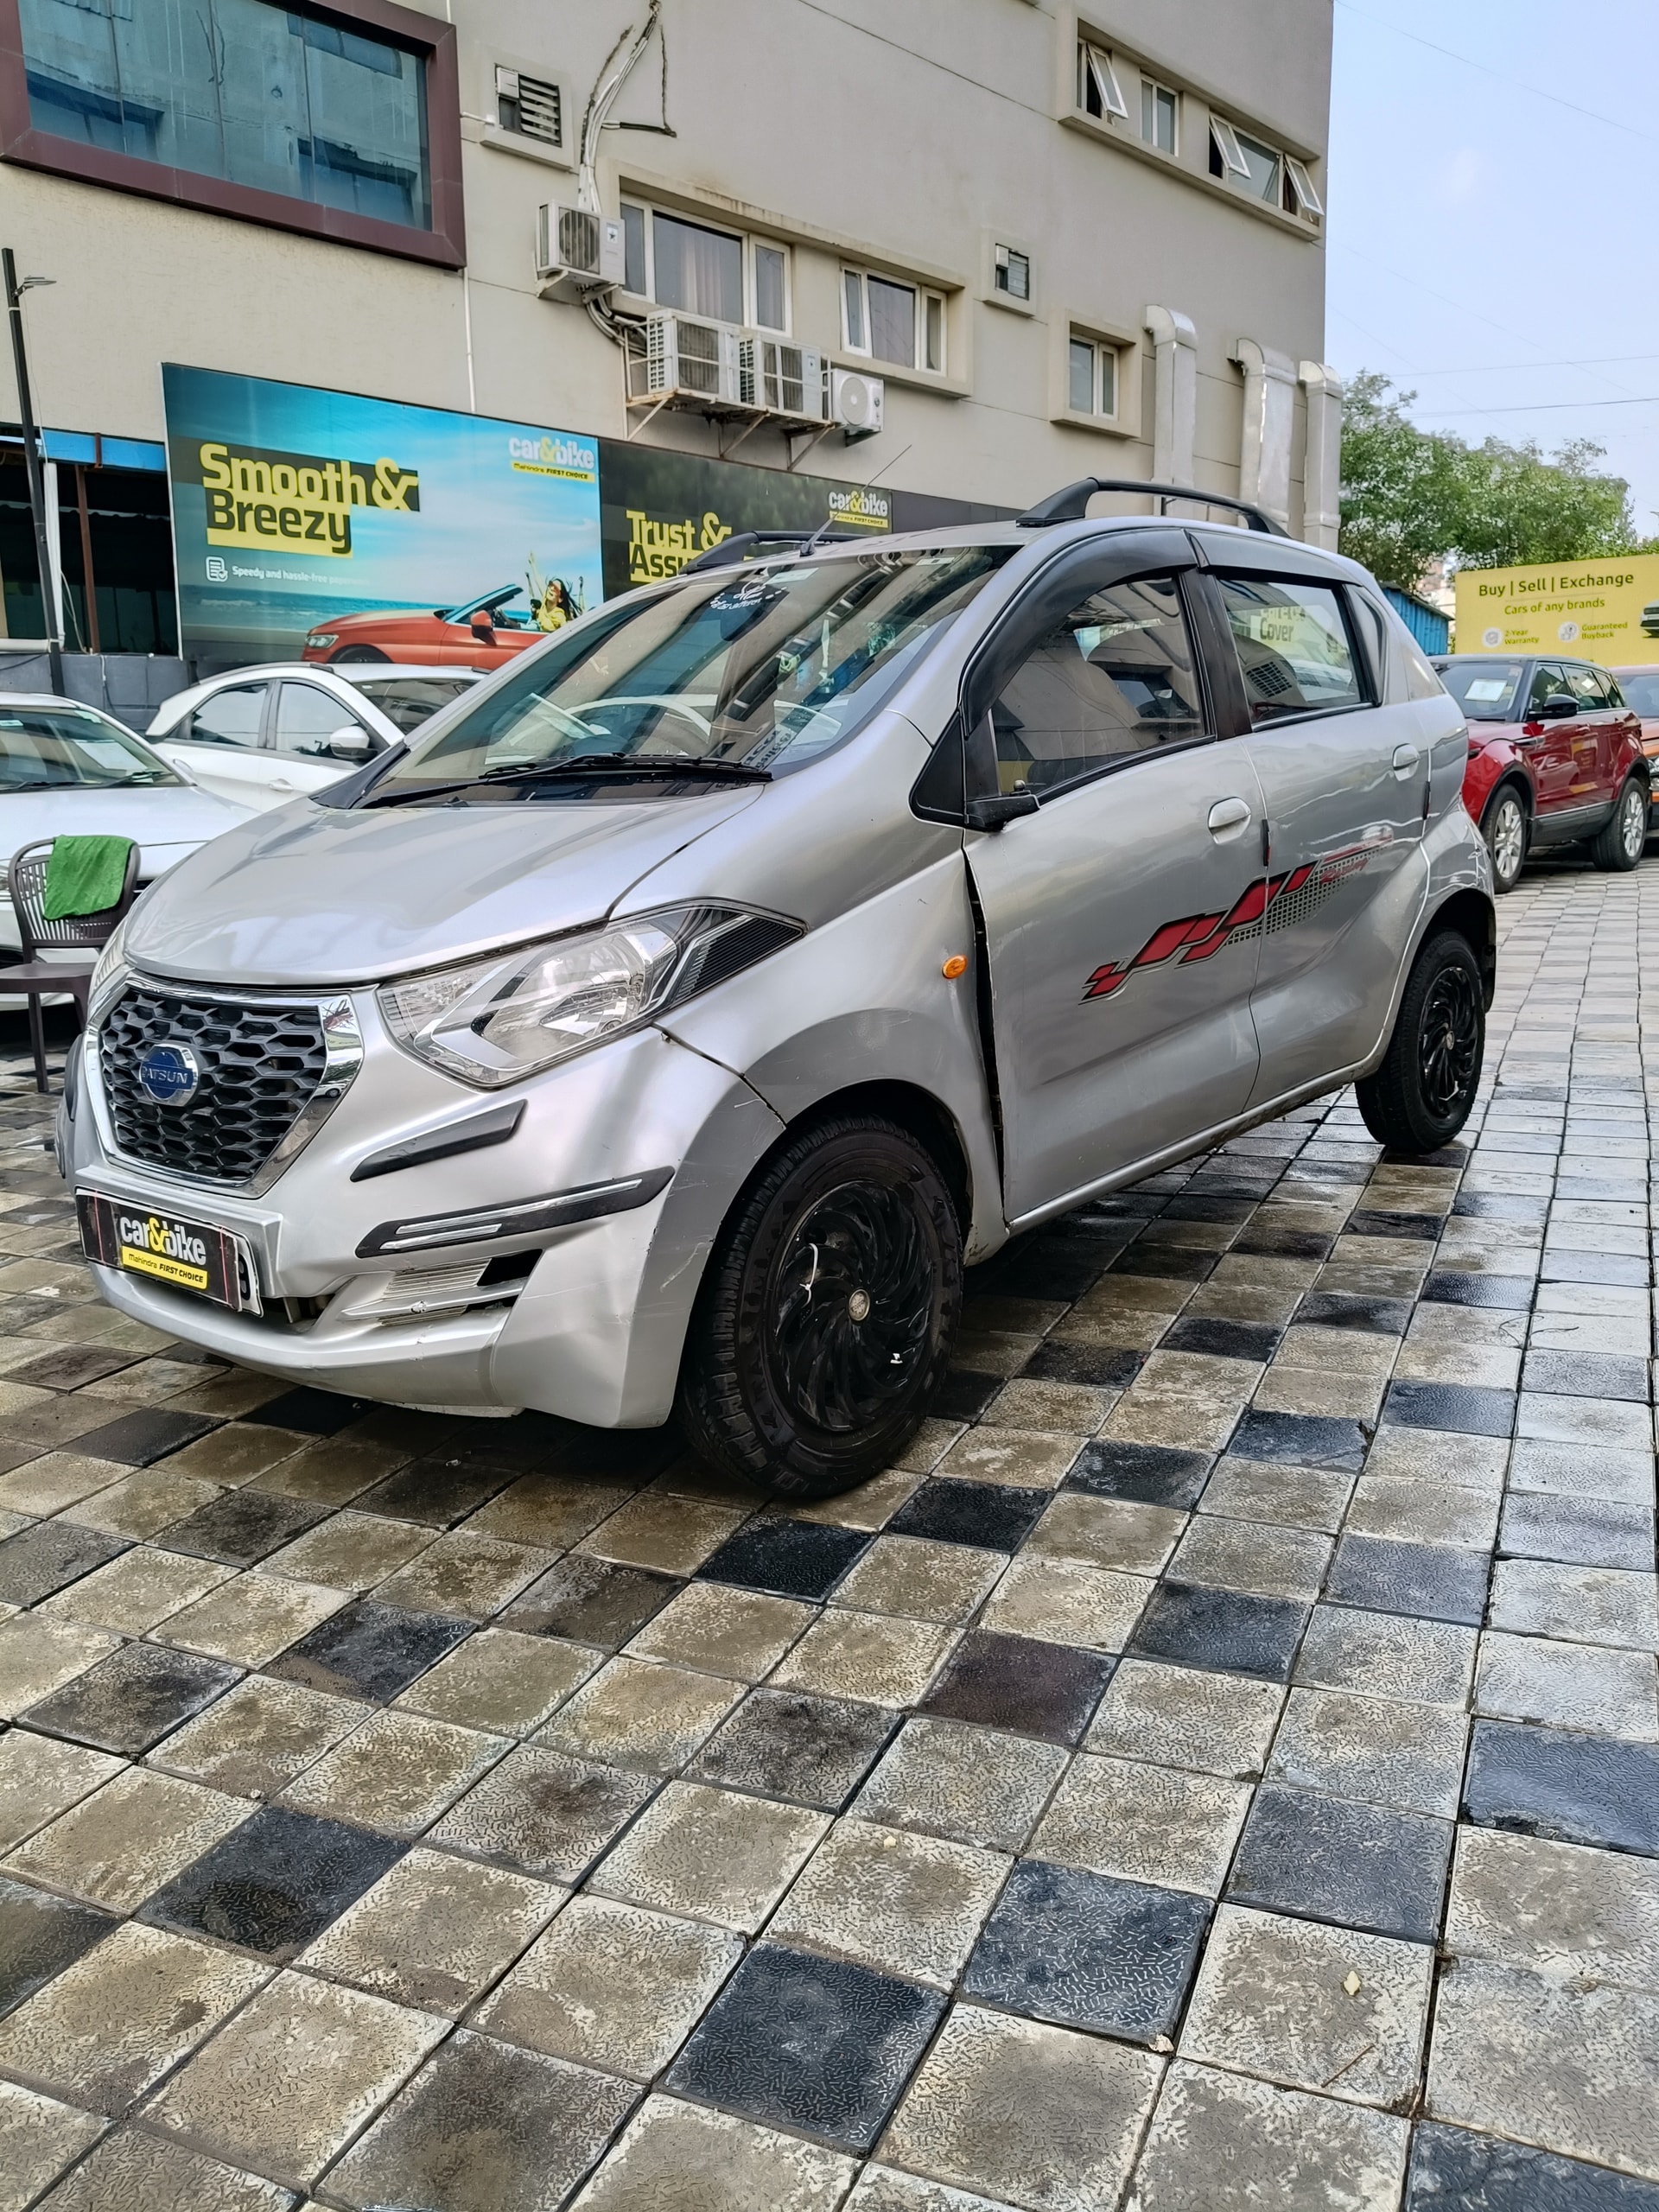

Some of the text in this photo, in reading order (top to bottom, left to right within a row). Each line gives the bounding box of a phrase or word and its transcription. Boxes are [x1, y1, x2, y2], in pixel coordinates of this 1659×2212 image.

[508, 436, 594, 469] car&bike
[199, 443, 419, 511] Smooth &
[566, 471, 588, 480] CHOICE
[829, 490, 888, 517] car&bike
[205, 487, 352, 554] Breezy
[626, 510, 732, 550] Trust &
[232, 565, 264, 580] Speedy
[266, 569, 282, 580] and
[283, 570, 327, 583] hassle-free
[1478, 584, 1505, 597] Buy
[1518, 578, 1547, 593] Sell
[1560, 574, 1634, 589] Exchange
[1504, 598, 1605, 615] Cars of any brands
[1260, 617, 1294, 642] Cover
[1581, 622, 1628, 632] Guaranteed
[1581, 632, 1614, 640] Buyback
[1504, 636, 1540, 645] Warranty
[119, 1217, 207, 1265] car&bike
[128, 1253, 204, 1283] Mahindra FIRST CHOICE
